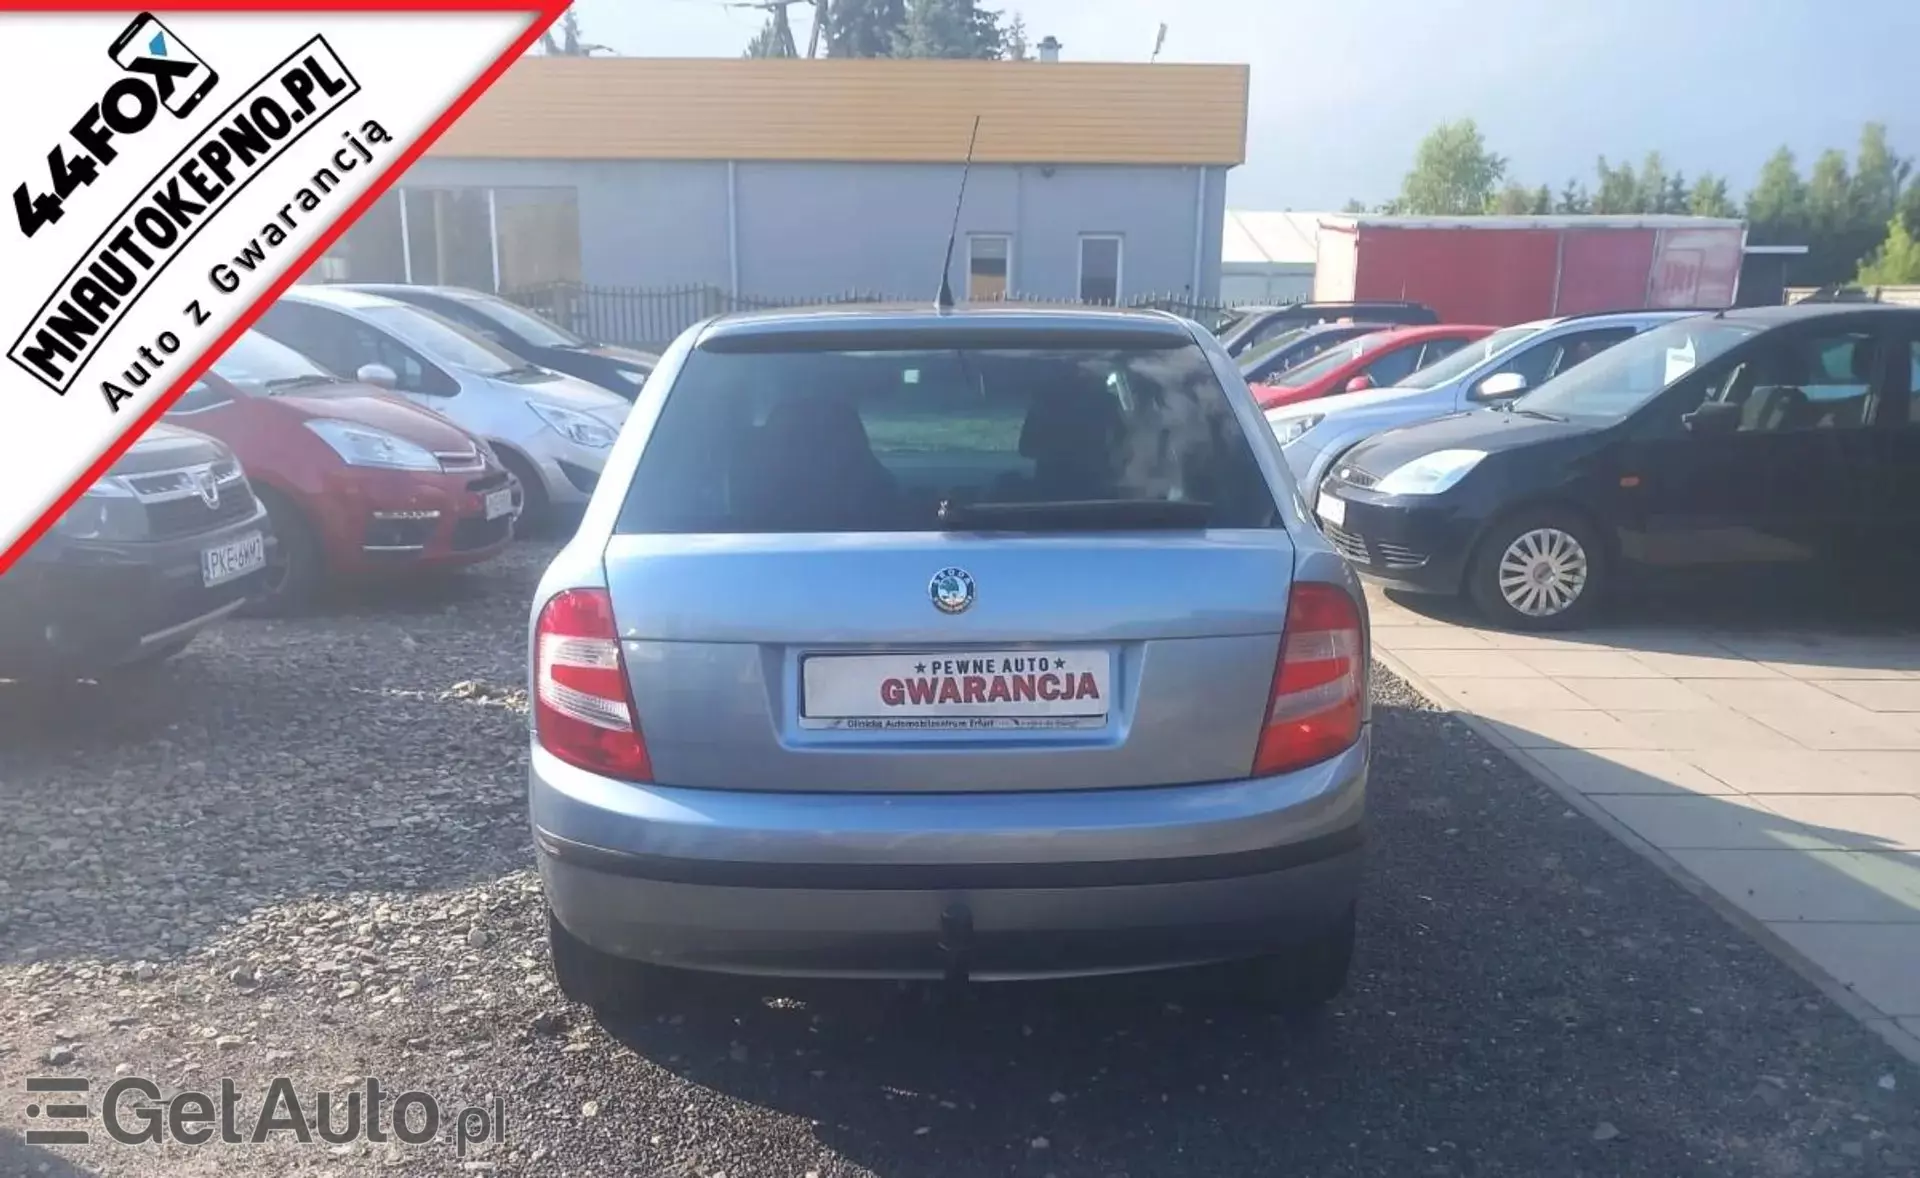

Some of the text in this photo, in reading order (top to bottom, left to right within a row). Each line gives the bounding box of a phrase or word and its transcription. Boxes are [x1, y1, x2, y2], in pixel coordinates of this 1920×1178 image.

[931, 657, 1050, 675] PEWNE AUTO
[880, 672, 1100, 707] GWARANCJA
